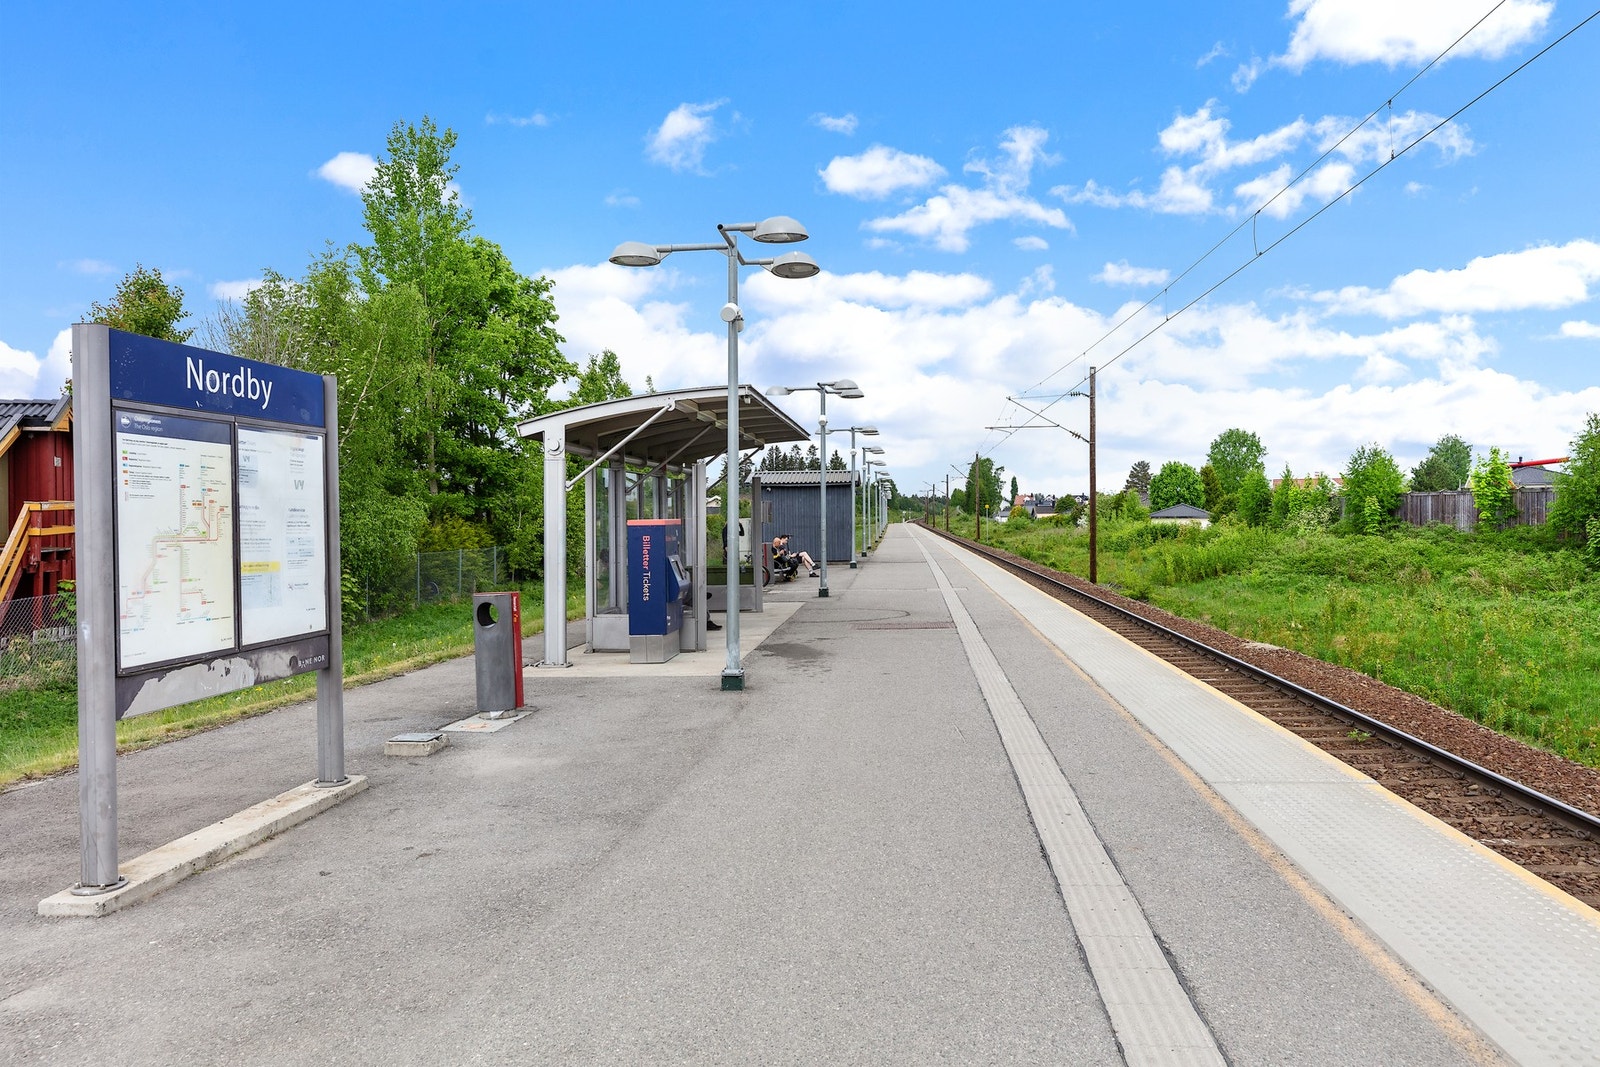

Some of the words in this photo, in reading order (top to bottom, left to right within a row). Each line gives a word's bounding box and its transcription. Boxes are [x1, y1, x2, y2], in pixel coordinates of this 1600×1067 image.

[186, 356, 273, 410] Nordby
[642, 535, 651, 569] Billetter
[642, 571, 651, 602] Tickets
[298, 657, 313, 669] BANE
[313, 654, 326, 663] NOR
